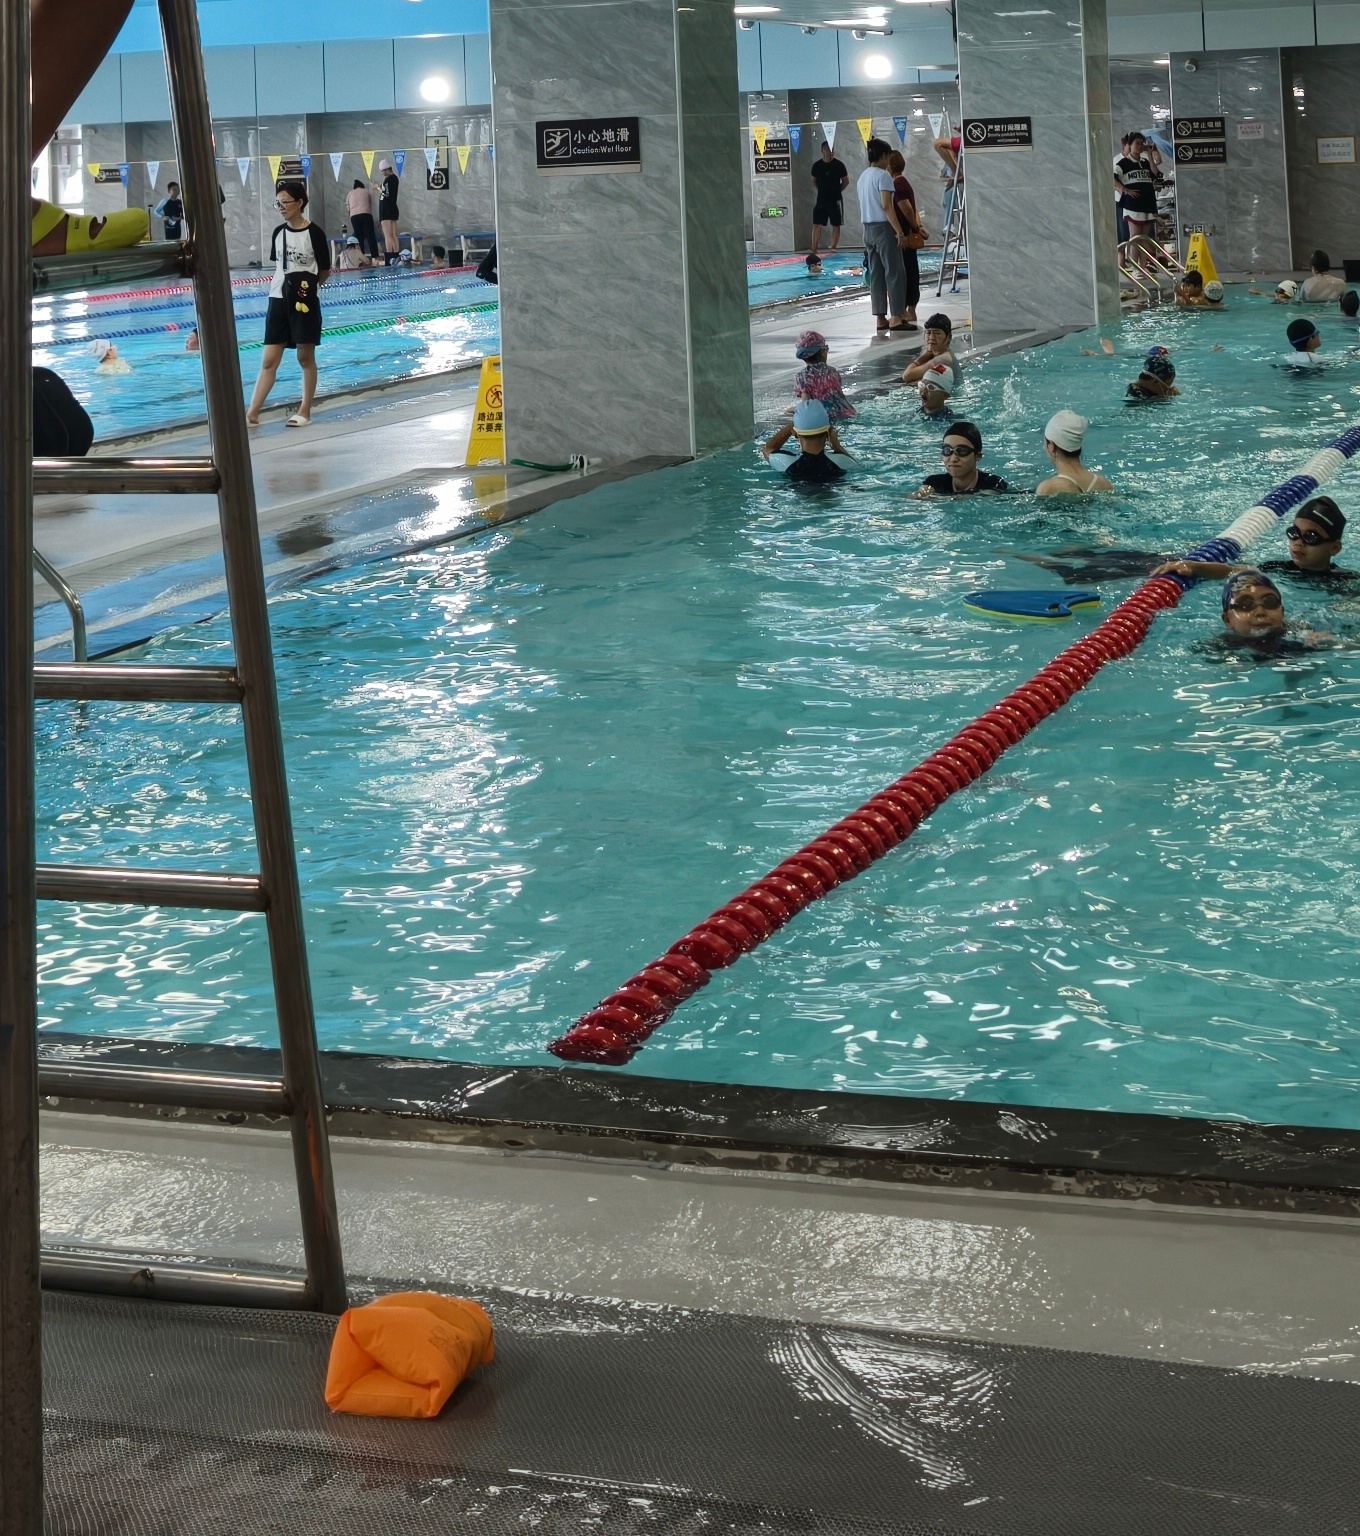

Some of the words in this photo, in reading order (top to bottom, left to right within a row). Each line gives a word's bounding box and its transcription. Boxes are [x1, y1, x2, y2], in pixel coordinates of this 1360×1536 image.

[573, 127, 630, 144] 小心地滑
[615, 144, 632, 153] floor
